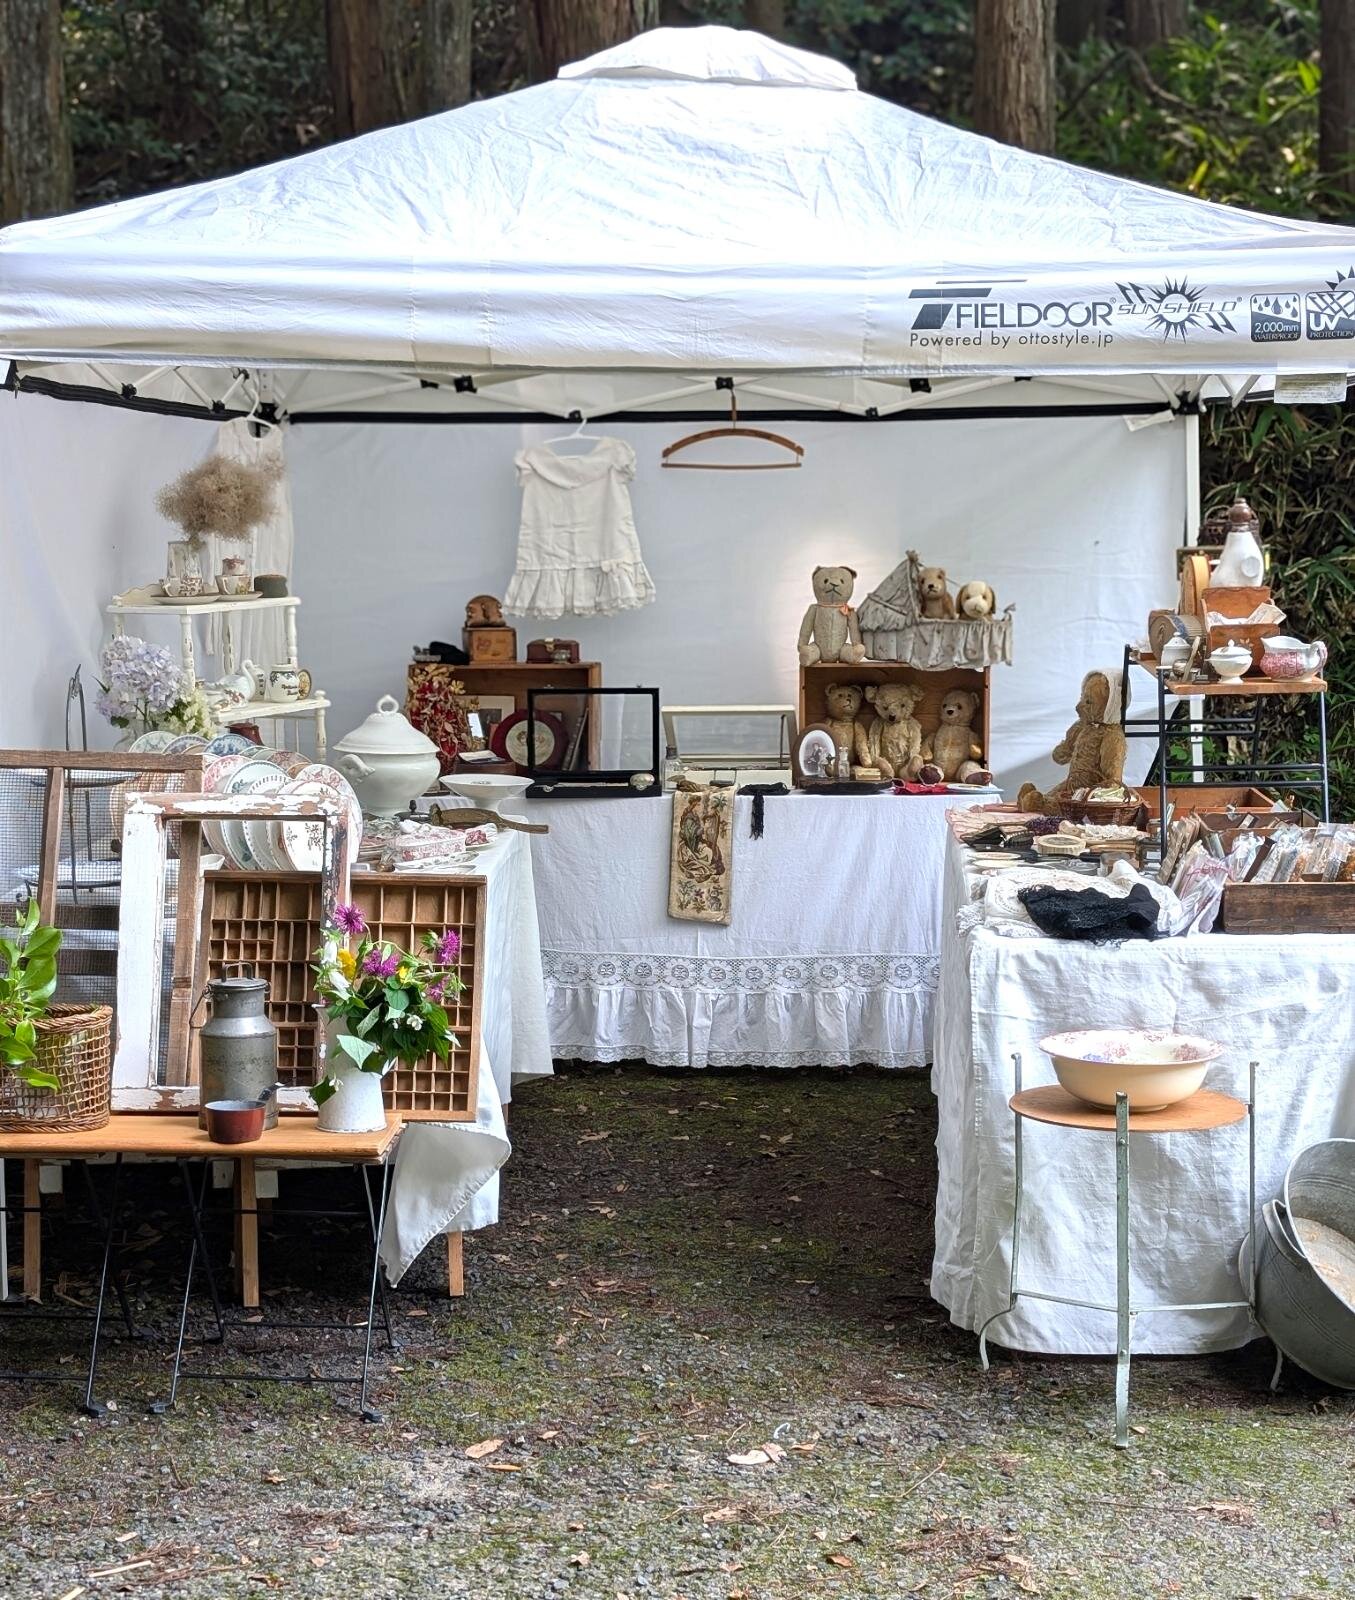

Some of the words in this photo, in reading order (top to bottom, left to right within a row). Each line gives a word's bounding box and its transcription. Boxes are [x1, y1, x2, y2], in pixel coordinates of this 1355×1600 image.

[956, 301, 1113, 328] FIELDOOR
[1310, 313, 1339, 331] UV
[910, 331, 982, 347] Powered
[991, 330, 1011, 348] by
[1019, 329, 1114, 348] ottostyle.jp
[1254, 332, 1298, 341] WATERPROOF
[1309, 330, 1354, 338] PROTECTION
